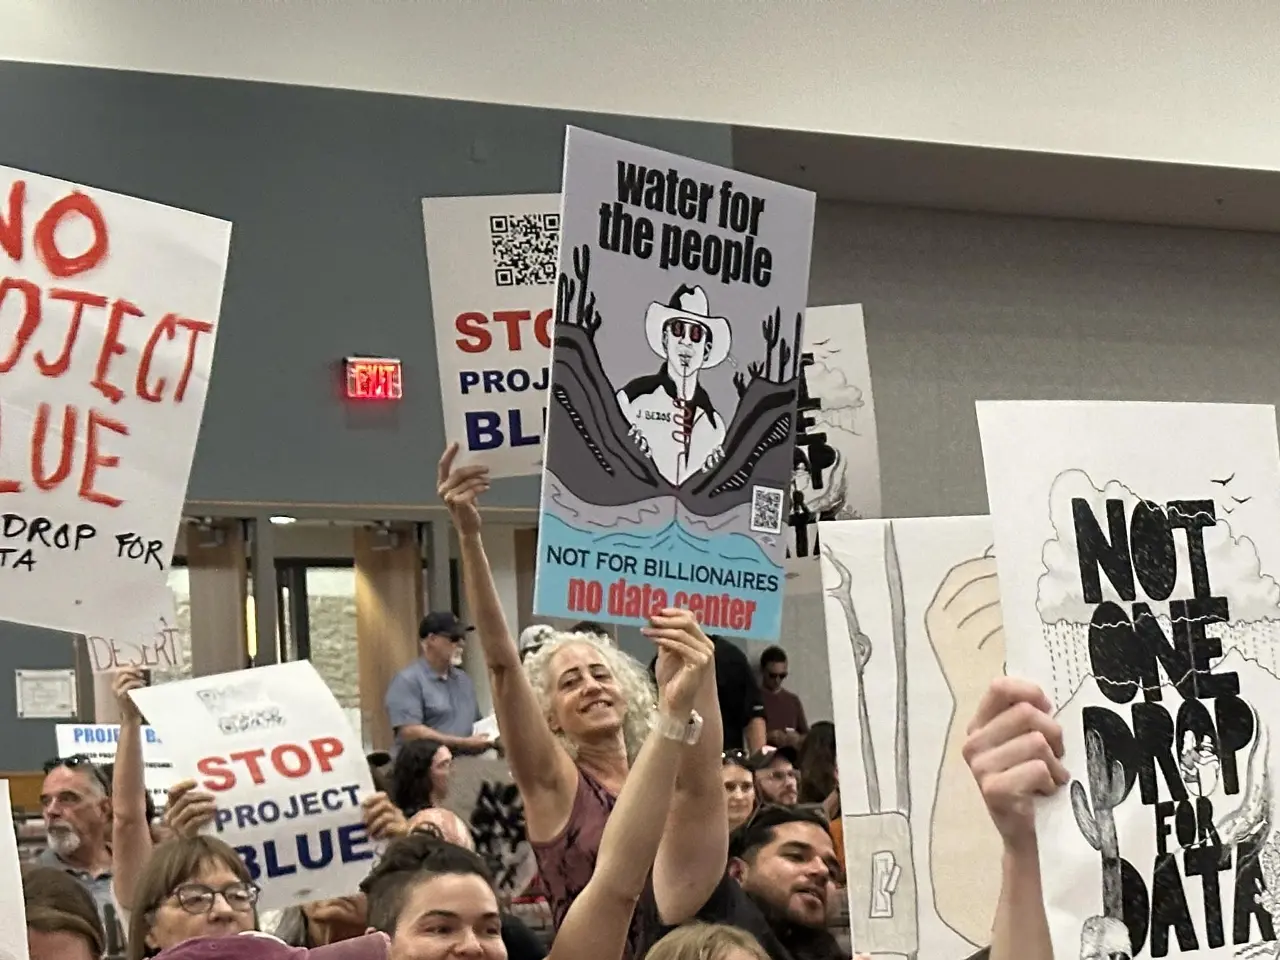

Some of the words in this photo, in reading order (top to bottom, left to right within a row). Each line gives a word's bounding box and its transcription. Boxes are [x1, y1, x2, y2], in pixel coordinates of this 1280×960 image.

[617, 160, 714, 223] water
[718, 180, 766, 237] for
[0, 180, 109, 277] NO
[599, 202, 654, 260] the
[659, 223, 772, 287] people
[356, 365, 394, 397] EXIT
[465, 406, 547, 451] BL
[2, 514, 96, 551] DROP
[116, 532, 163, 571] FOR
[546, 545, 590, 568] NOT
[596, 552, 637, 575] FOR
[643, 558, 780, 592] BILLIONAIRES
[1072, 498, 1216, 604] NOT
[567, 578, 604, 612] no
[1088, 596, 1242, 704] ONE
[197, 737, 344, 792] STOP
[1082, 695, 1257, 806] DROP
[215, 785, 360, 833] PROJECT
[1156, 798, 1221, 855] FOR
